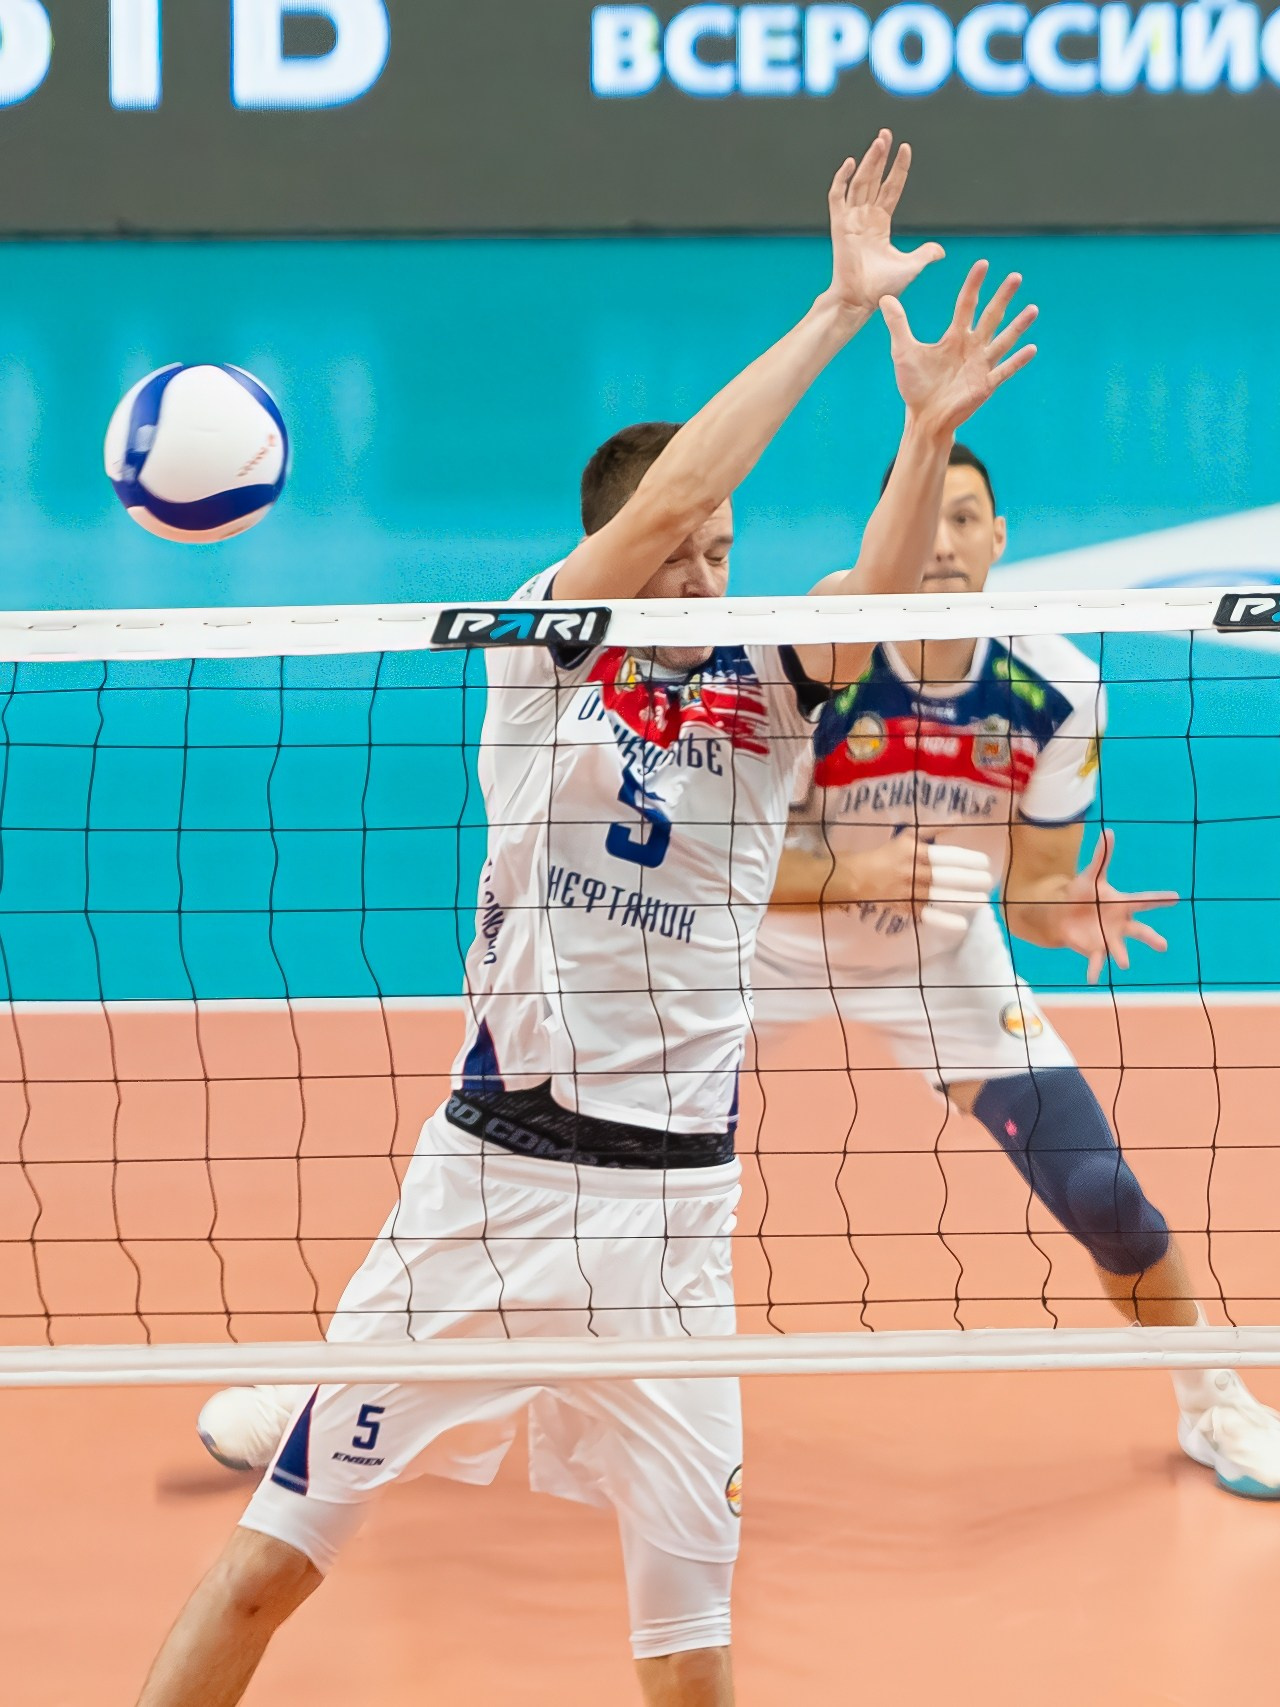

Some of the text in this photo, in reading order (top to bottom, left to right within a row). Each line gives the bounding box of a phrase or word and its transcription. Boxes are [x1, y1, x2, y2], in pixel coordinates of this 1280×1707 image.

[448, 612, 597, 641] PARI
[549, 865, 697, 943] НЕФТЯНИК
[352, 1404, 386, 1450] 5
